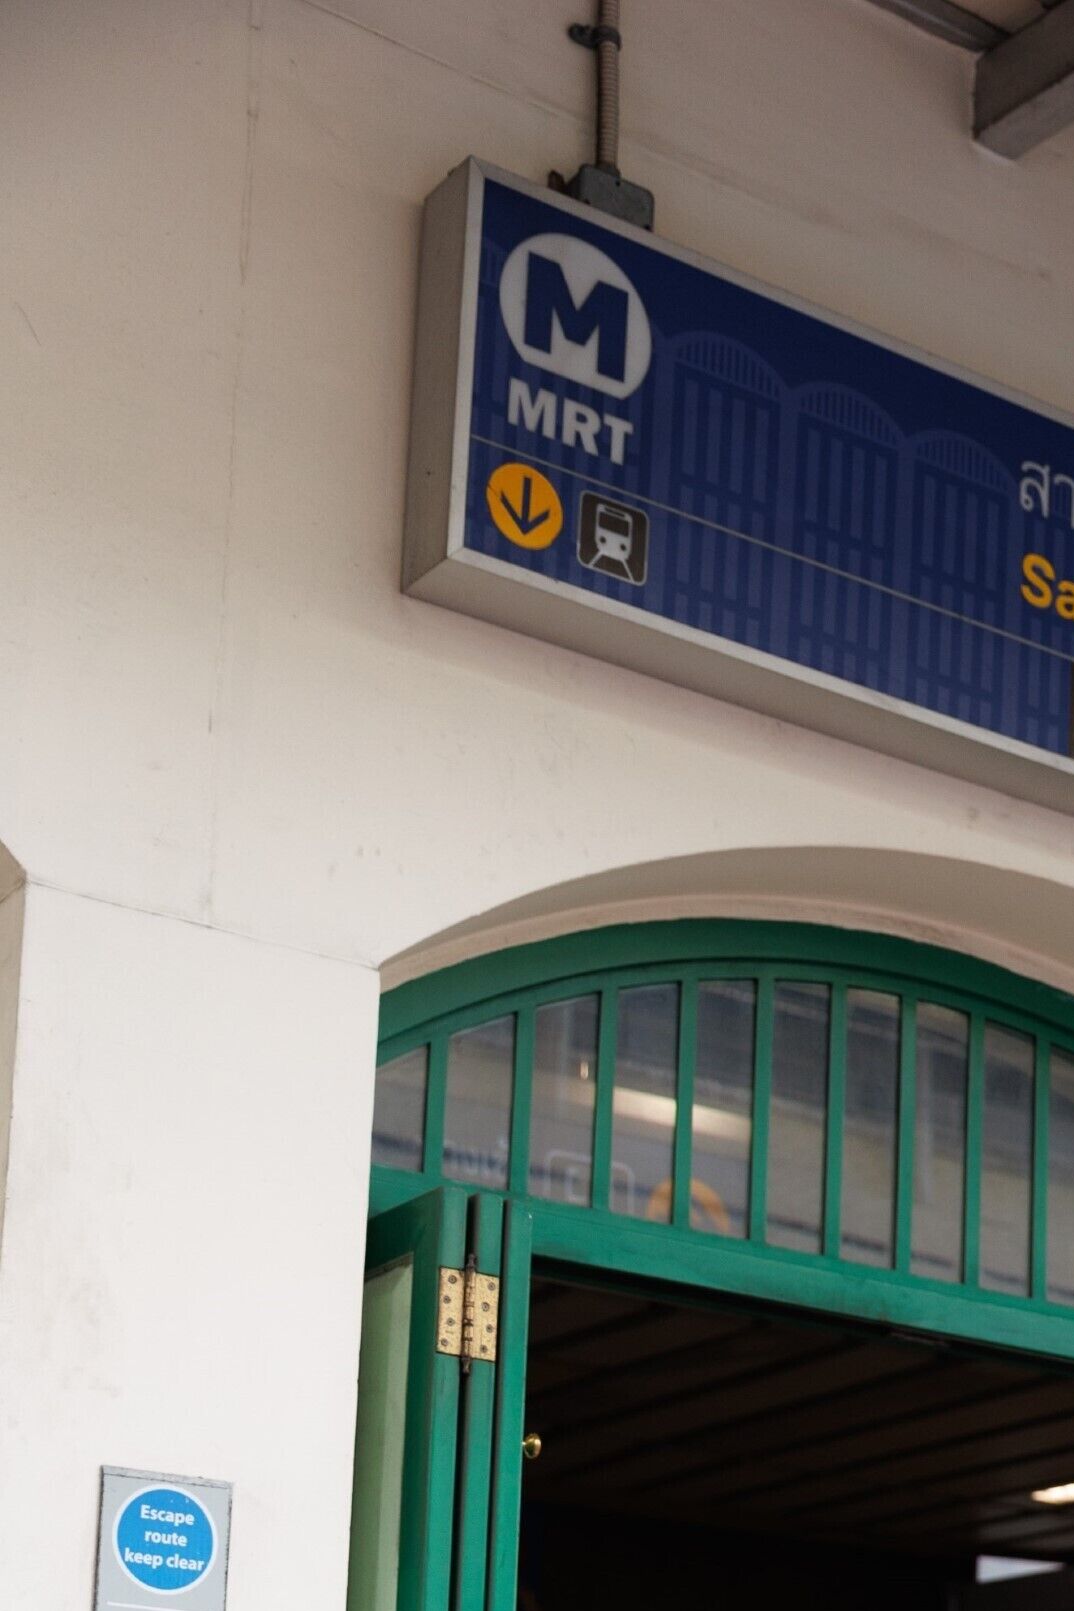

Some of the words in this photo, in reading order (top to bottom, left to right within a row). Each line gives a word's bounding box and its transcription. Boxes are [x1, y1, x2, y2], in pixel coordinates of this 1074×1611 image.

[508, 378, 634, 466] MRT
[139, 1503, 196, 1527] Escape
[144, 1529, 188, 1547] route
[124, 1547, 164, 1569] keep
[166, 1553, 206, 1572] clear
